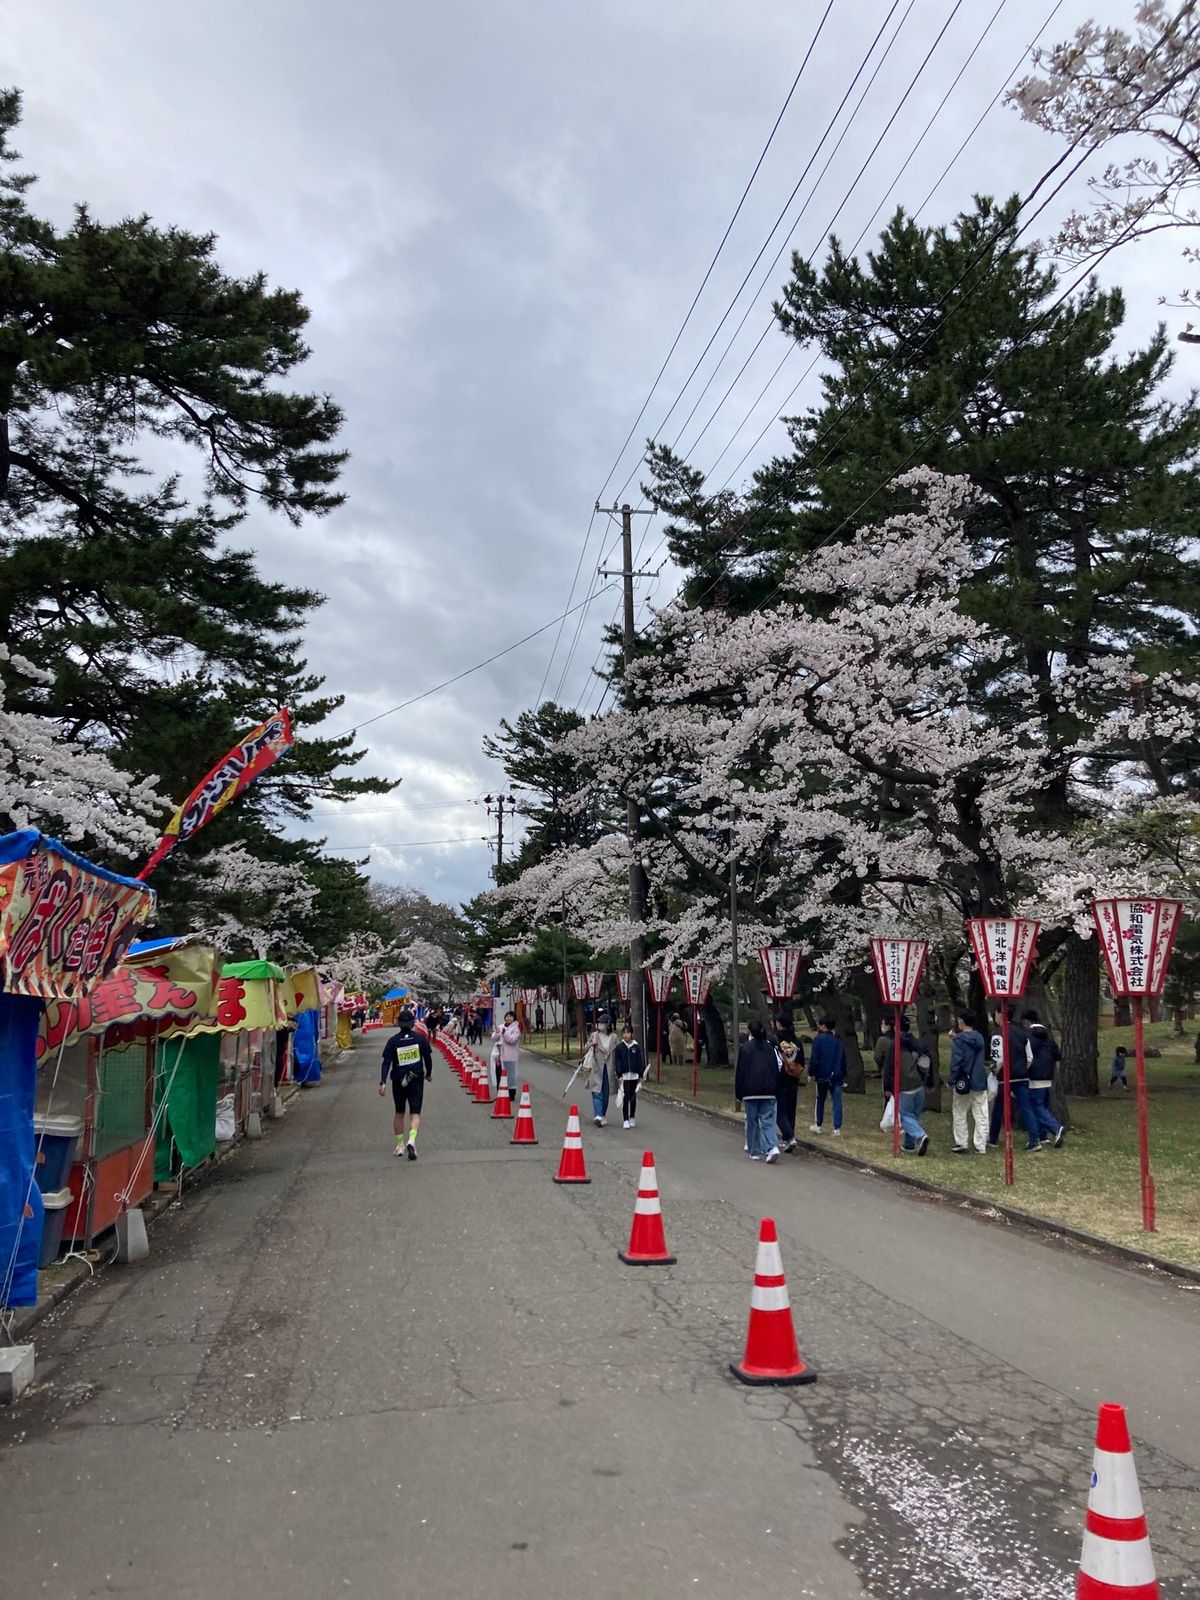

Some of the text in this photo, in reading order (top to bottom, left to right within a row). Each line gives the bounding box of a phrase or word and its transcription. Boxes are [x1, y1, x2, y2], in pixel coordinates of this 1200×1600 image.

[995, 937, 1008, 991] 北洋電設
[1129, 902, 1144, 987] 協和電気株式会社
